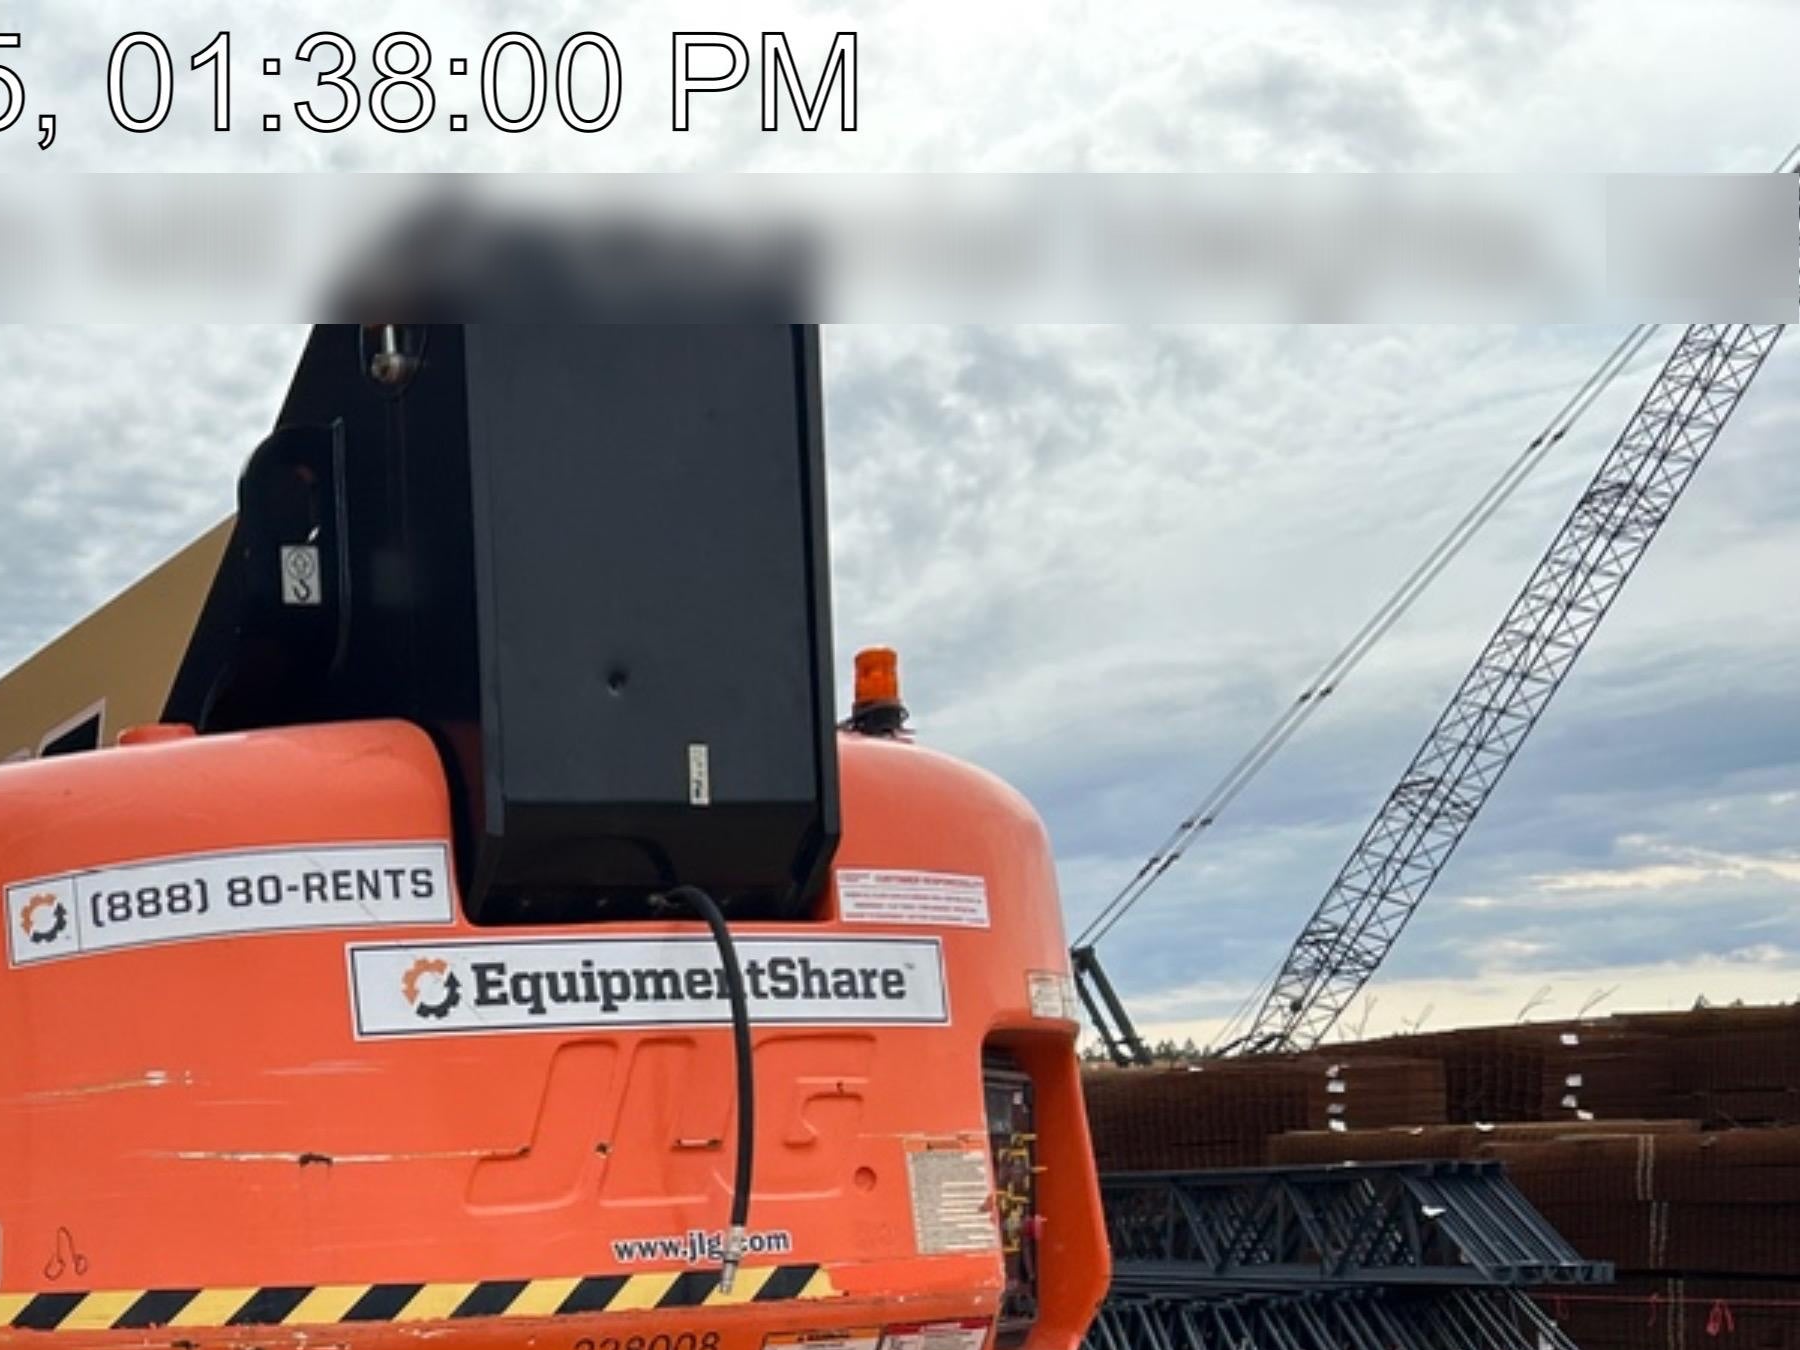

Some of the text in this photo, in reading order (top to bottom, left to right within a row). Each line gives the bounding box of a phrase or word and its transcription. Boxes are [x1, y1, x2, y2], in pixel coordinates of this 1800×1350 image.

[90, 868, 435, 927] (888) 80-RENTS
[613, 1230, 791, 1263] www.jlgcom
